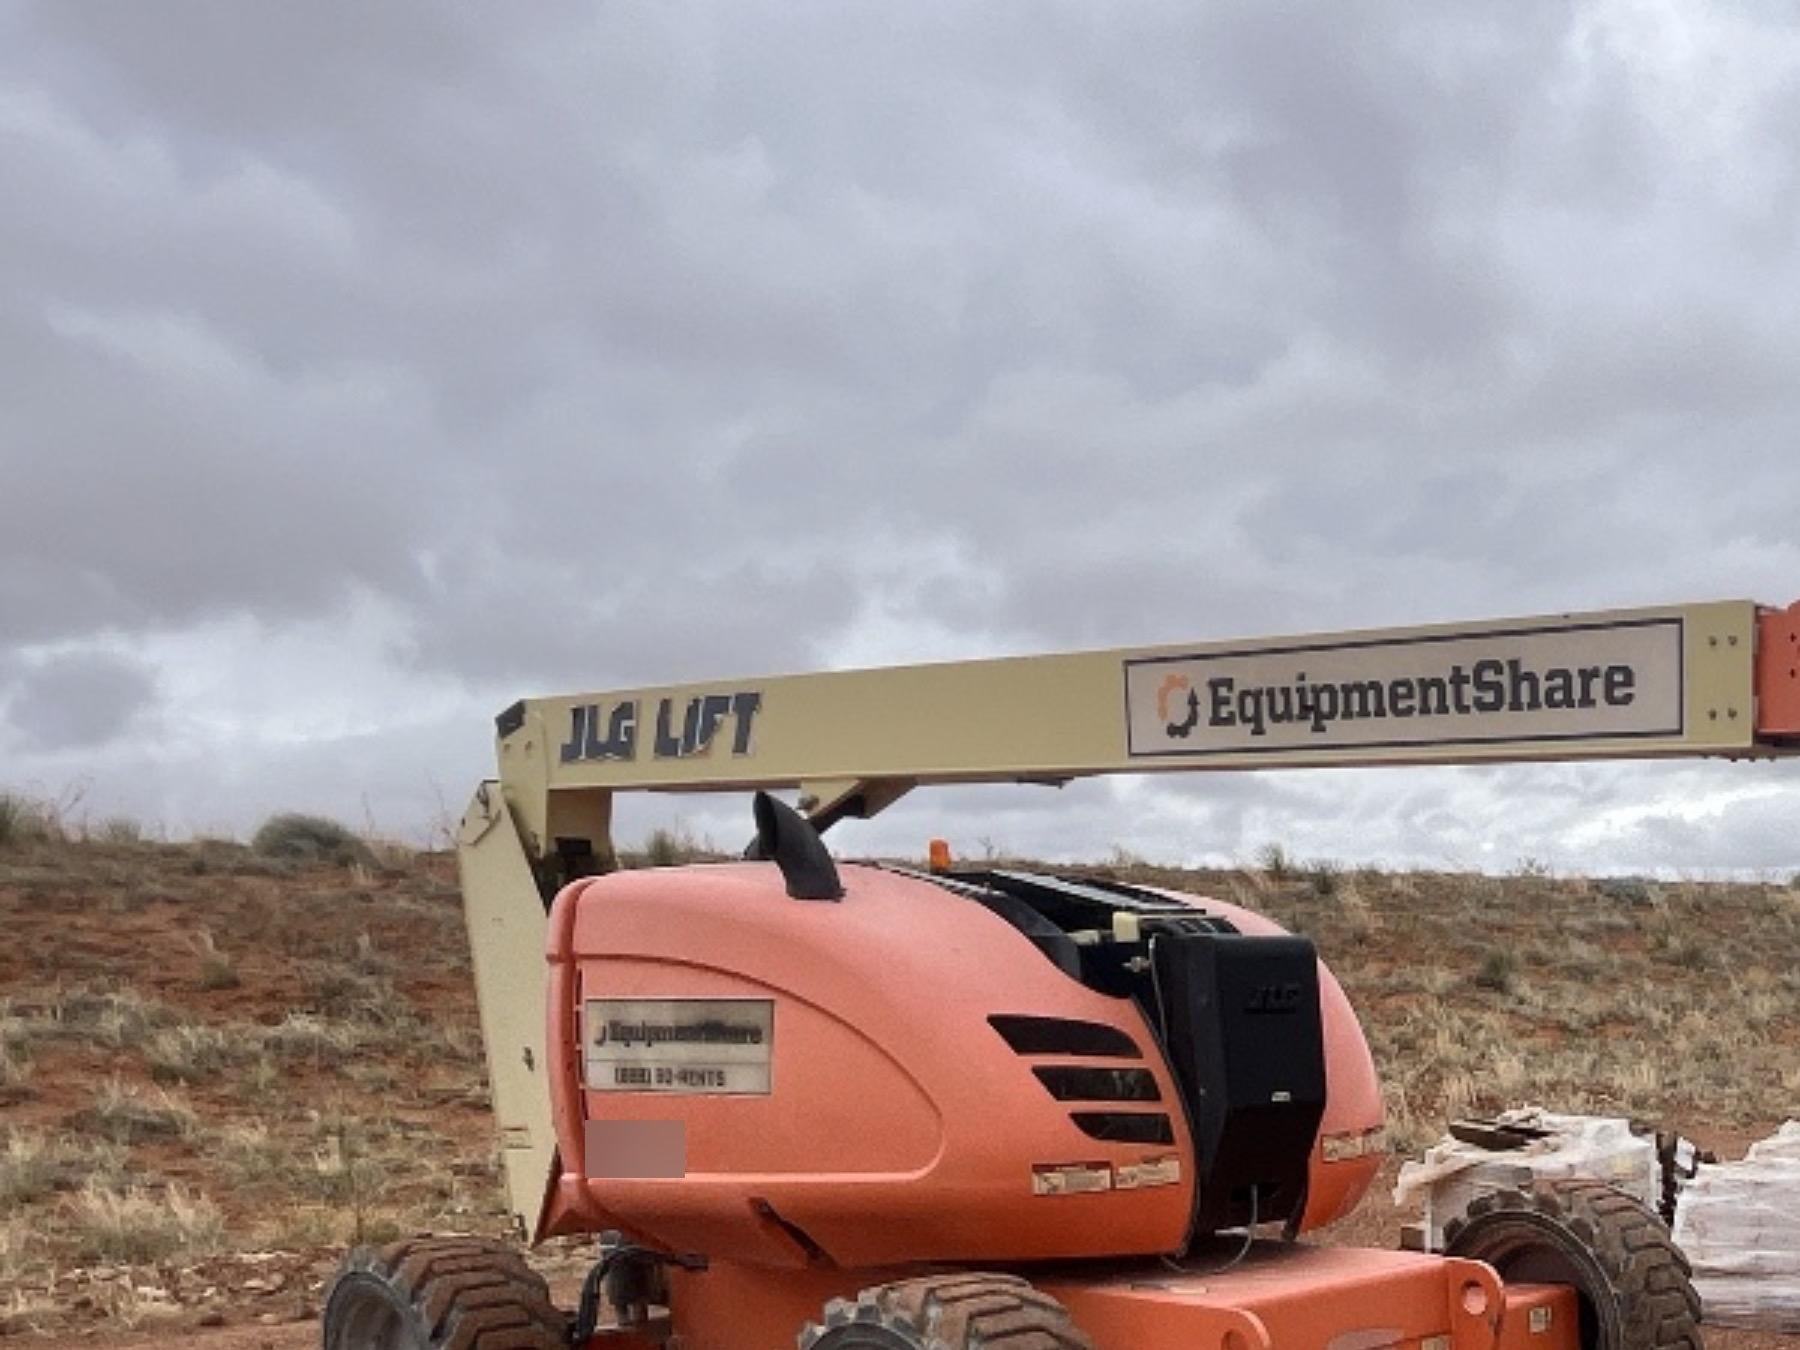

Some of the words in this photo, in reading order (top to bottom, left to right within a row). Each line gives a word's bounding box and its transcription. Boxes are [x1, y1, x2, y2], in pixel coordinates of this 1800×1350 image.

[558, 702, 638, 763] JLG
[653, 691, 762, 759] LIFT
[1207, 658, 1635, 736] EquipmentShare
[608, 1019, 763, 1048] Equipmentare
